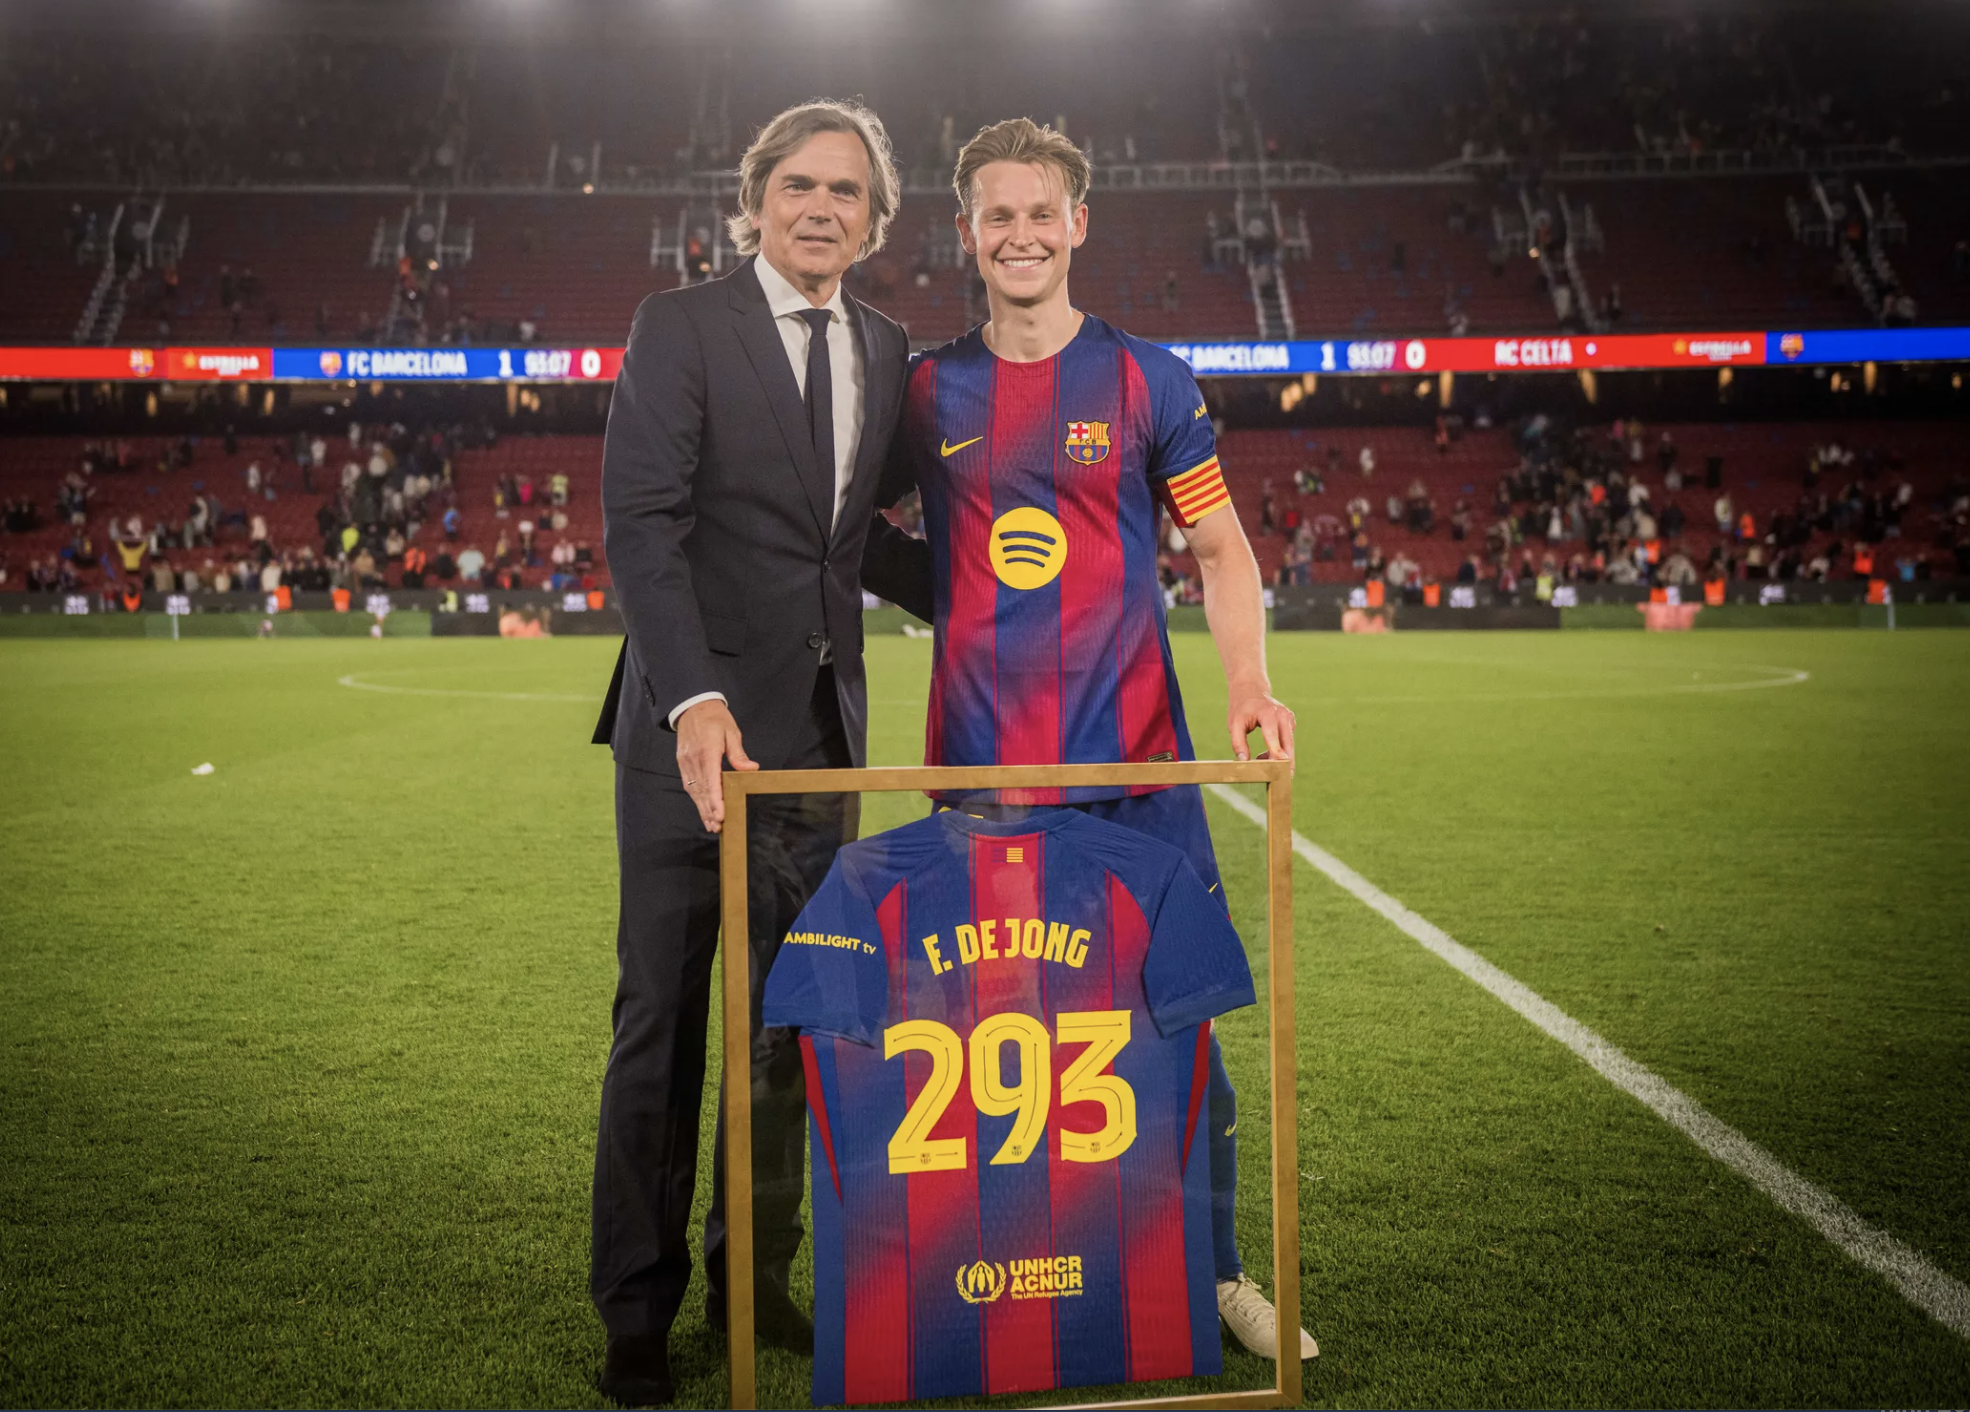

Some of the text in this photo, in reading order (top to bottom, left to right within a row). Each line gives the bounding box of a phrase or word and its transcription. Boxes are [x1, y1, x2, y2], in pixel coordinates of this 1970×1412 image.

[347, 351, 467, 377] FC BARCELONA
[499, 350, 513, 377] 1
[581, 350, 601, 378] 0
[1191, 345, 1290, 371] BARCELONA
[1321, 342, 1336, 371] 1
[1405, 340, 1426, 370] 0
[1520, 339, 1573, 366] CELTA
[783, 931, 877, 955] AMBILIGHT tv
[922, 933, 953, 976] F.
[1004, 918, 1092, 968] JONG
[884, 1010, 1137, 1174] 293
[1009, 1255, 1083, 1276] UNHCR
[1010, 1272, 1083, 1293] ACNUR
